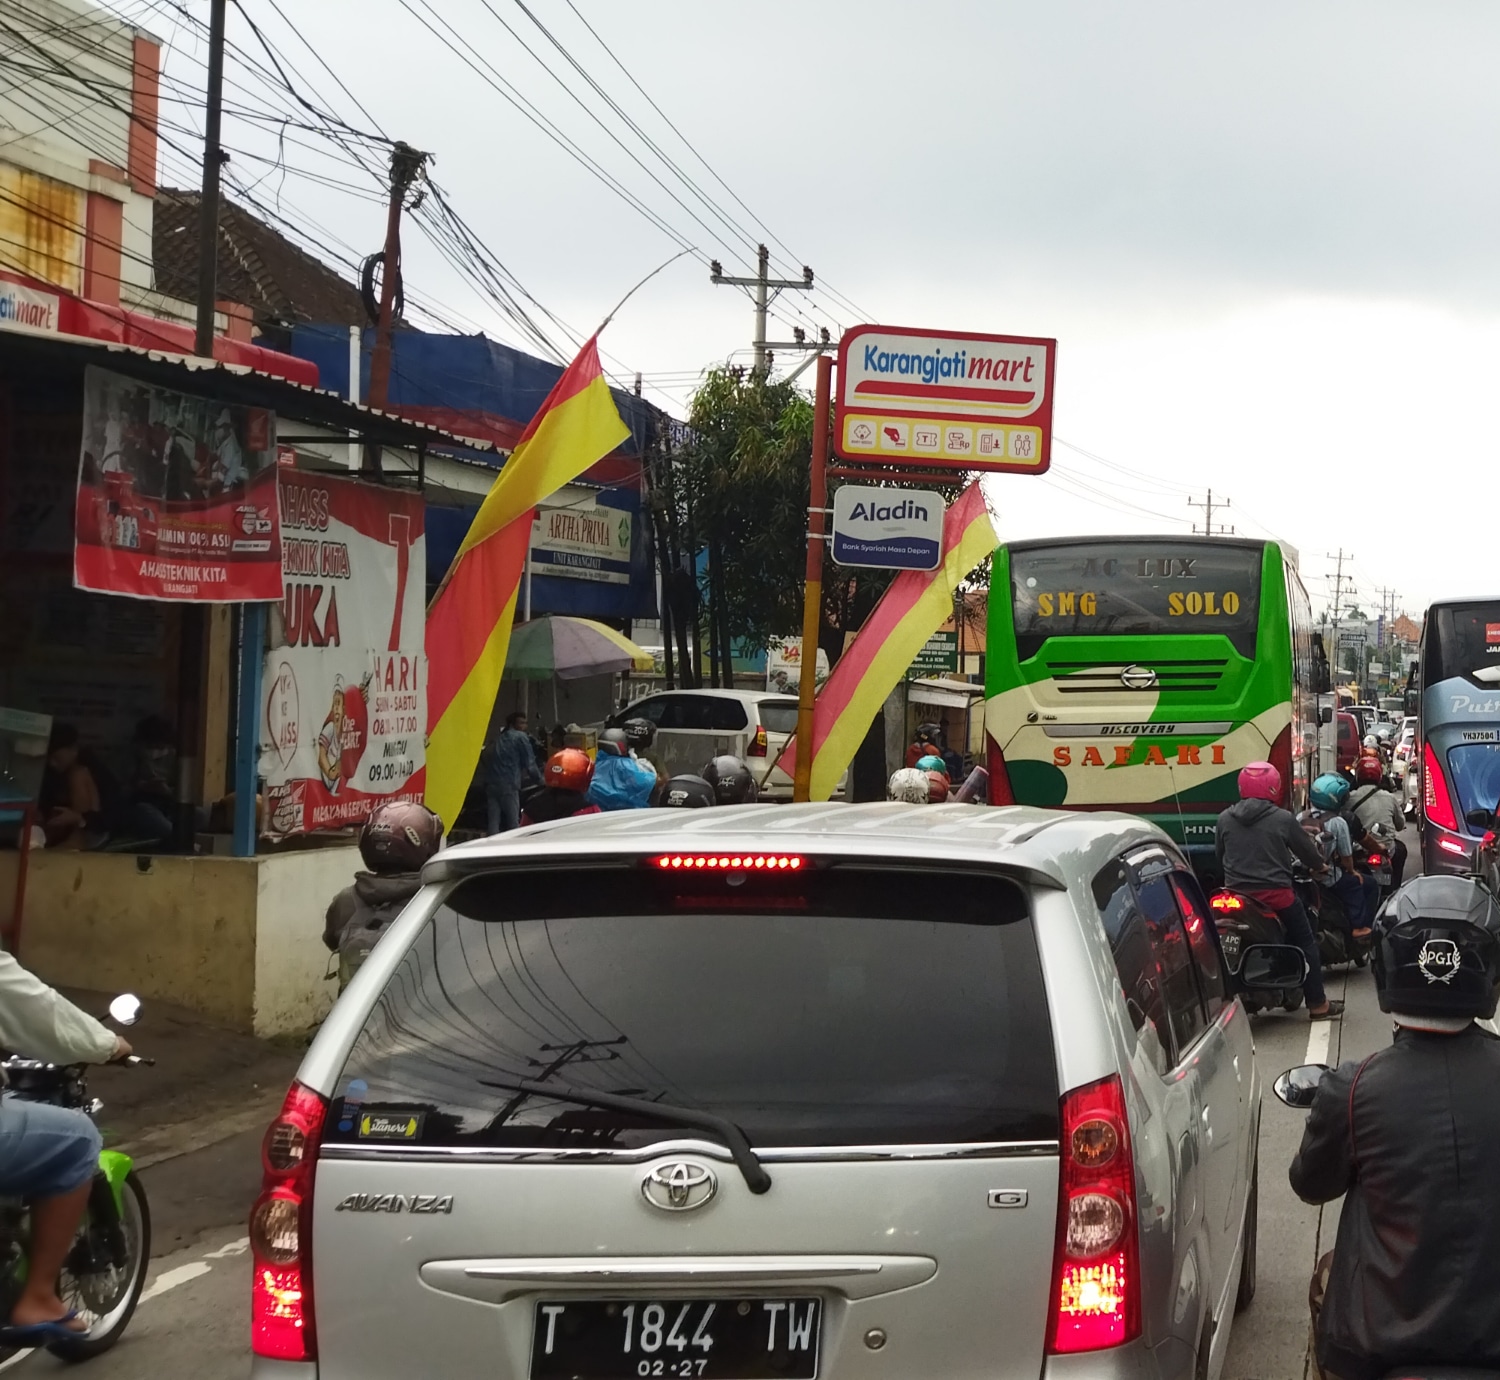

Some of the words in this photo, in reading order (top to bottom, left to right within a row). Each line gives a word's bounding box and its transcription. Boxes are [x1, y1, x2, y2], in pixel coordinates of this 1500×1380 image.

[848, 500, 928, 522] Aladin
[547, 514, 579, 542] ARTHA
[581, 519, 609, 546] PRIMA
[320, 541, 350, 579] KITA
[842, 543, 859, 551] Bank
[861, 544, 887, 552] Syariah
[908, 547, 930, 555] Depan
[165, 564, 201, 581] TEKNIK
[202, 567, 227, 582] KITA
[1081, 558, 1118, 578] AC
[1135, 558, 1197, 579] LUX
[388, 513, 411, 652] 7
[1038, 591, 1097, 617] SMG
[1168, 591, 1240, 616] SOLO
[284, 583, 340, 648] UKA
[374, 655, 418, 692] HARI
[394, 696, 417, 711] SABTU
[396, 716, 417, 733] 17.00
[1101, 724, 1176, 735] DISCOVERY
[1053, 745, 1226, 767] SAFARI
[1185, 826, 1217, 834] HIN
[335, 1193, 454, 1215] AVANZA
[994, 1192, 1022, 1205] G
[541, 1305, 565, 1354] T
[622, 1303, 716, 1353] 1844
[763, 1302, 815, 1351] TW
